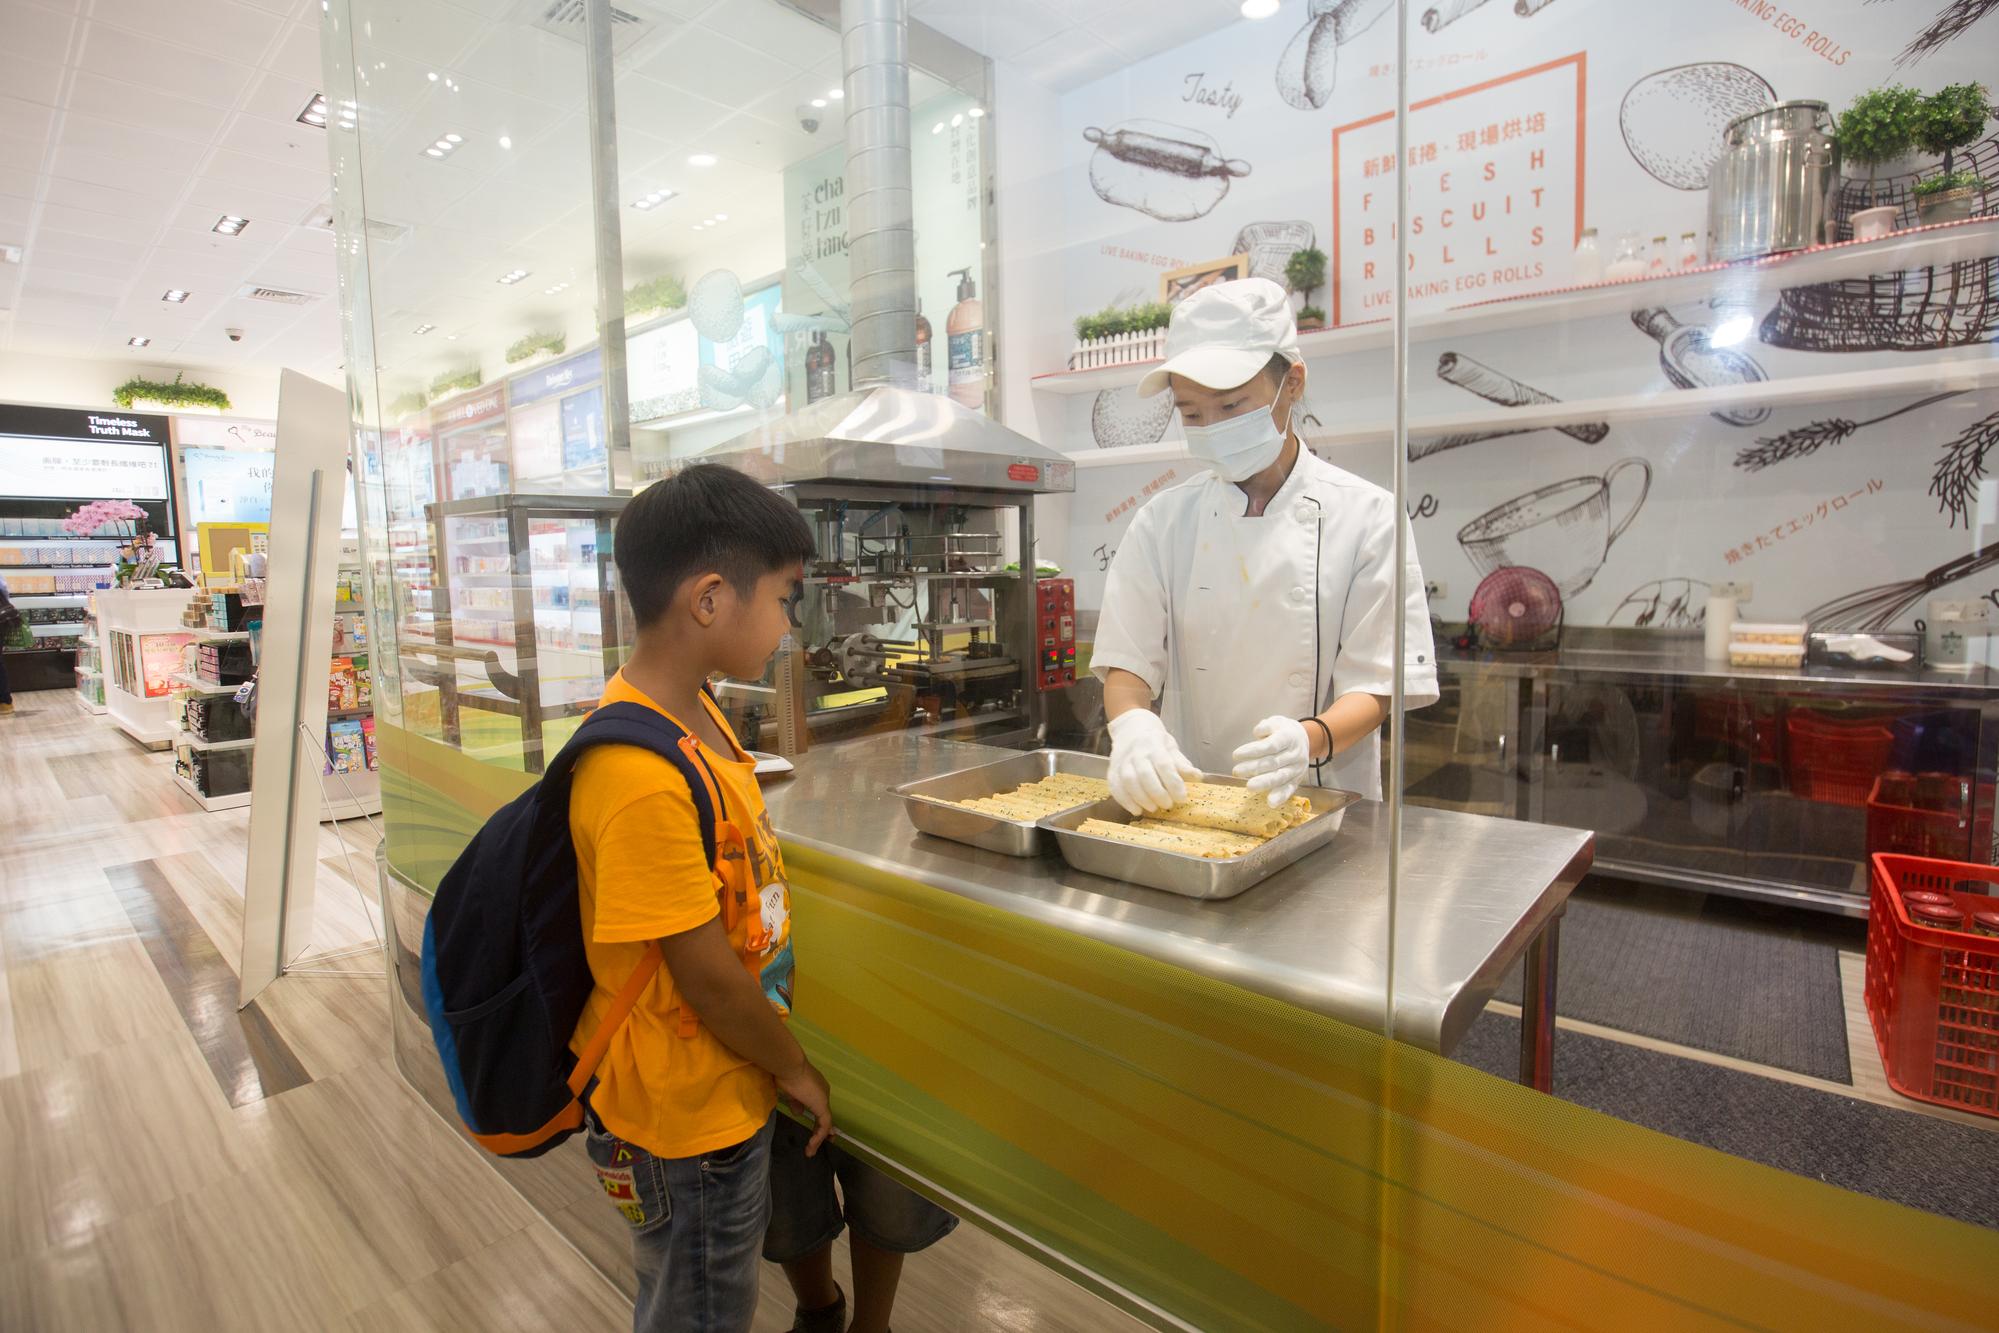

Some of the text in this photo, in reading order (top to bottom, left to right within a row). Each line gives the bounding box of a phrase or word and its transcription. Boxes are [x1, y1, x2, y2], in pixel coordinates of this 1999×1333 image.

[1773, 12, 1806, 38] EGG
[1802, 31, 1851, 66] ROLLS
[1182, 72, 1243, 119] Tasty
[814, 176, 843, 204] cha
[1363, 149, 1544, 211] FESH
[1363, 262, 1543, 308] LIVE AKING EGG ROLLS
[88, 416, 137, 428] Timeless
[89, 425, 150, 438] Truth Mask
